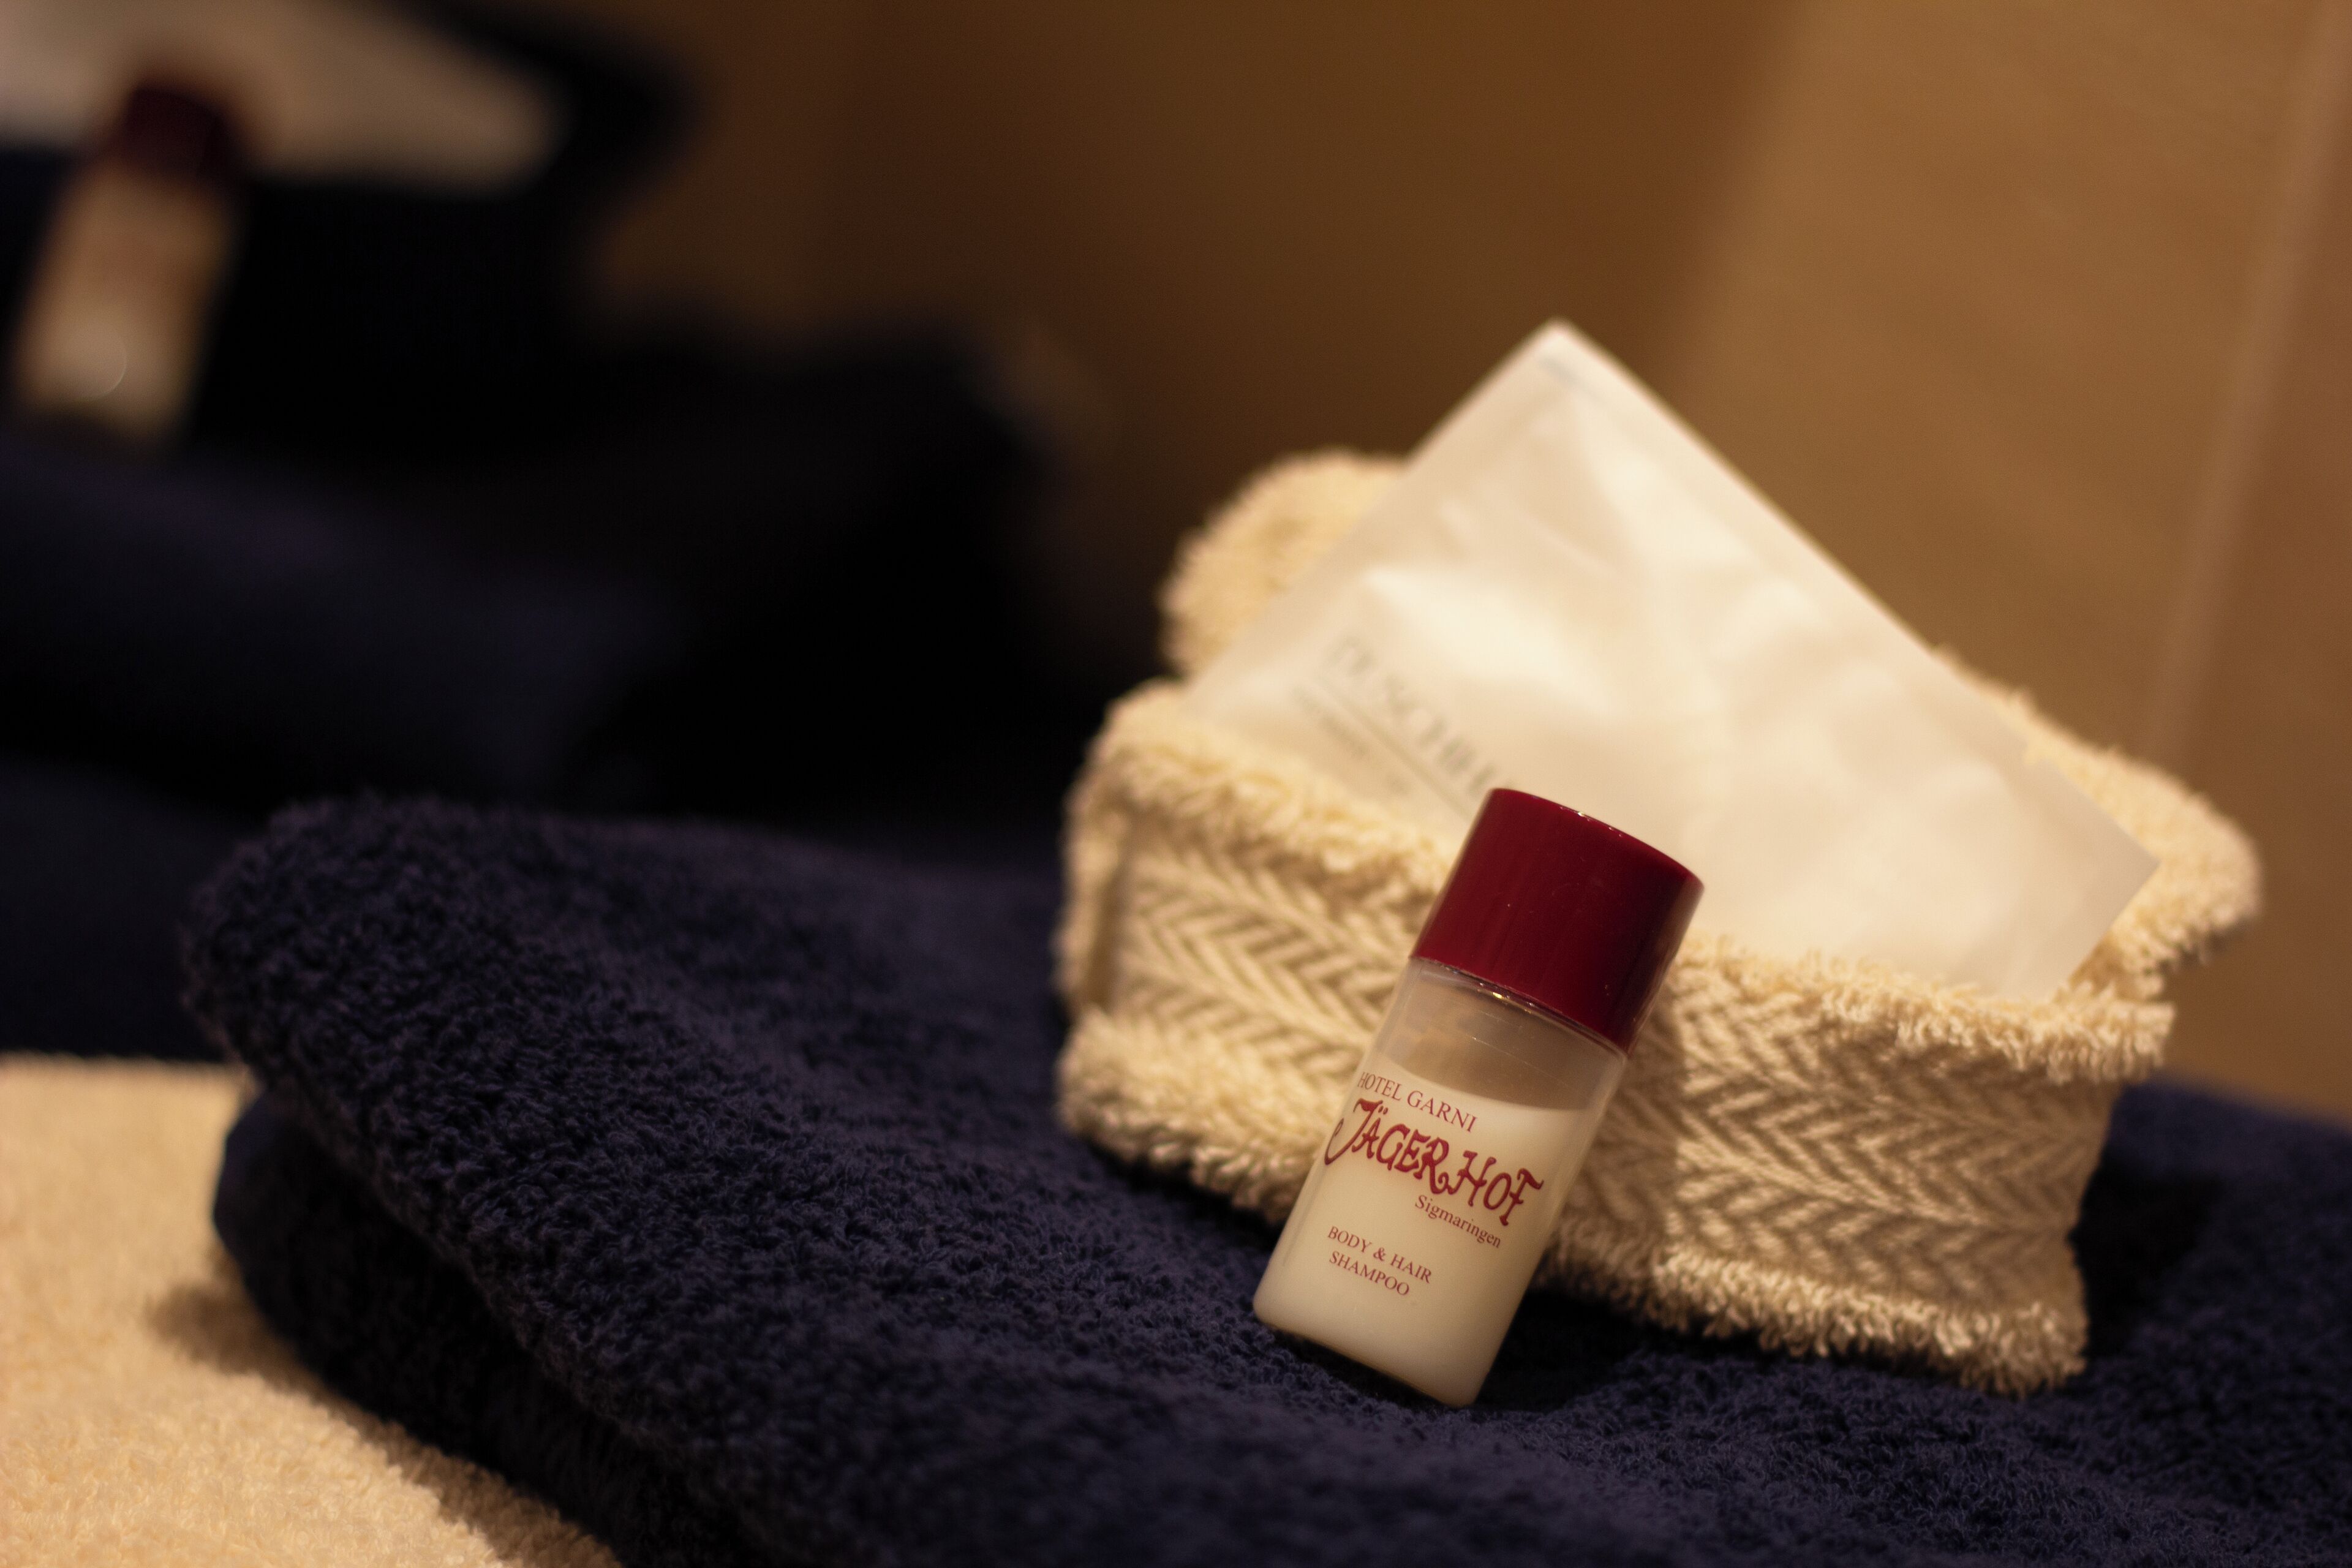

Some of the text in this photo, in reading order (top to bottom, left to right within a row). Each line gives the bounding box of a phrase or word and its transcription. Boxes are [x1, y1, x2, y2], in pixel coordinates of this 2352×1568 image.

[1357, 1071, 1478, 1133] HOTEL GARNI
[1414, 1194, 1502, 1248] Sigmaringen
[1327, 1226, 1433, 1283] BODY & HAIR
[1329, 1250, 1411, 1295] SHAMPOO
